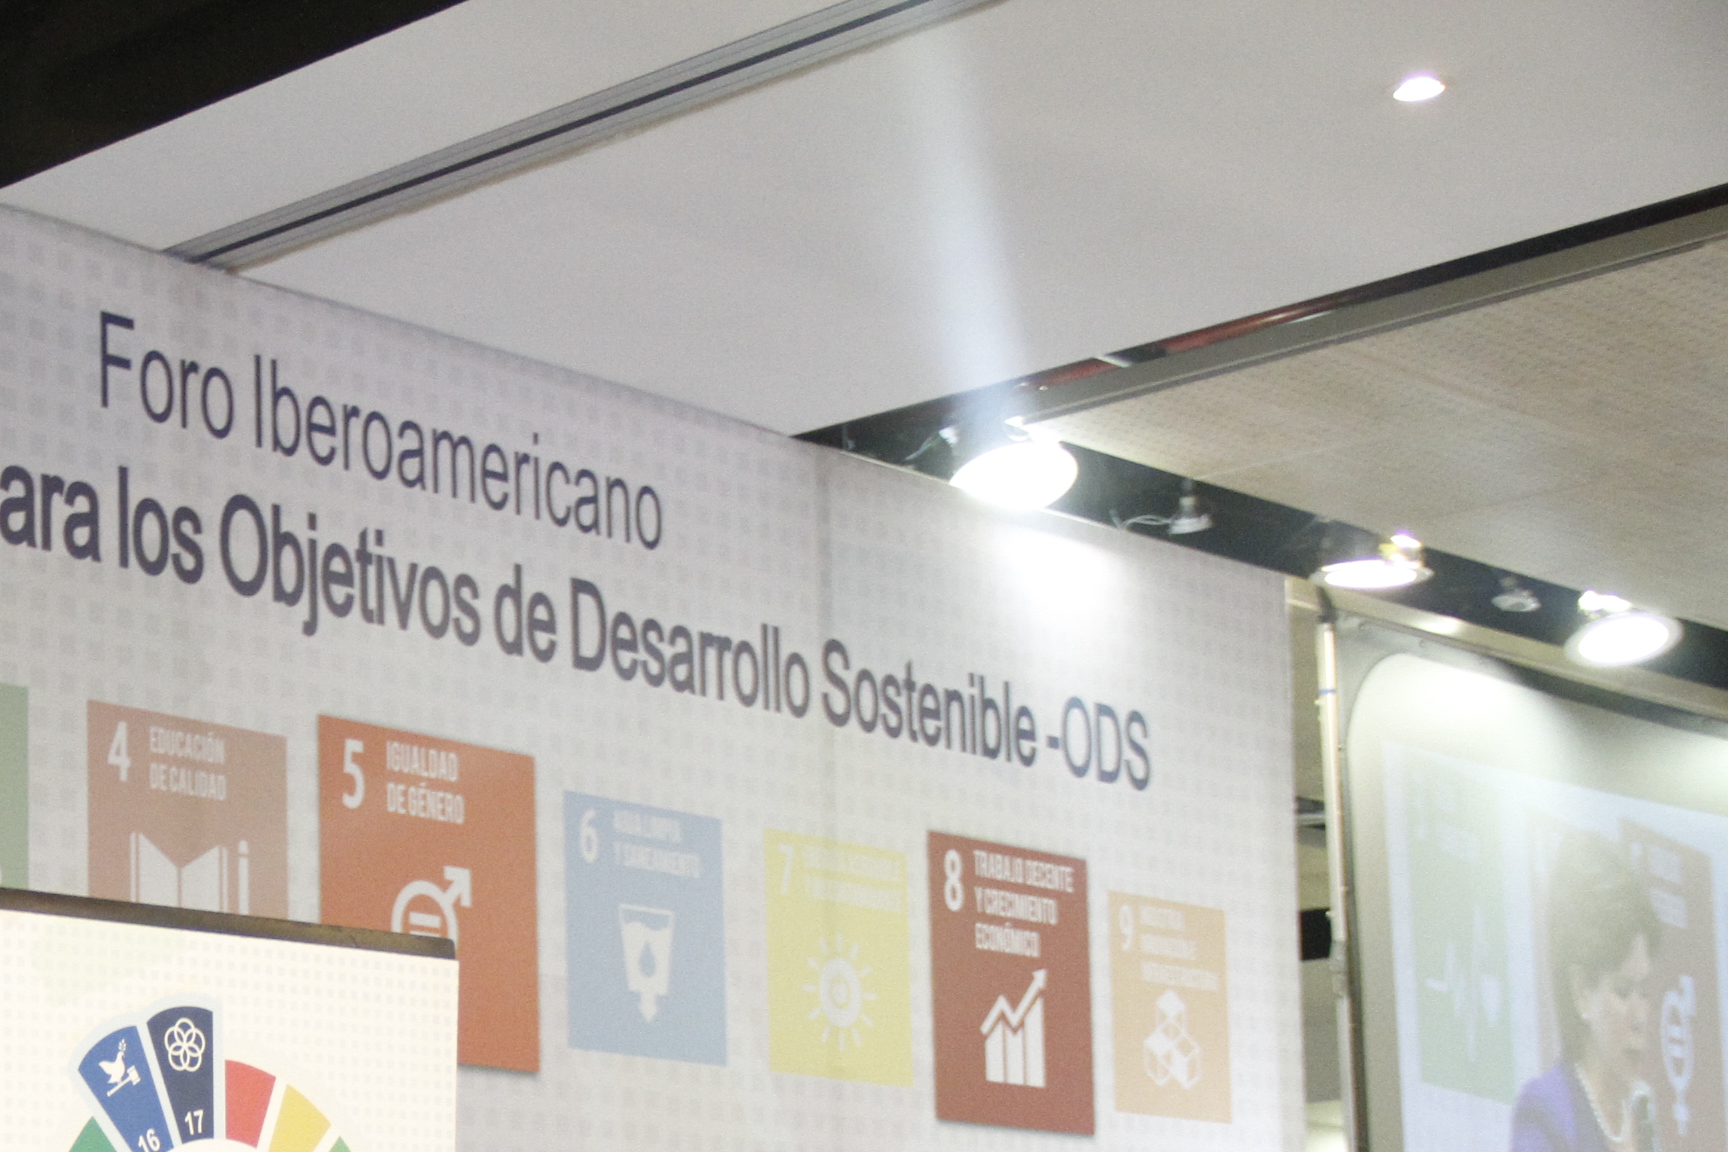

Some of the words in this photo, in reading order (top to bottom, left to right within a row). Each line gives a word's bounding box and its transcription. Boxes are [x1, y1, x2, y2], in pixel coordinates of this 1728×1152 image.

[99, 311, 234, 439] Foro
[254, 355, 662, 550] Iberoamericano
[118, 466, 204, 584] los
[219, 493, 480, 646] Objetivos
[495, 563, 557, 663] de
[570, 577, 809, 718] Desarrollo
[822, 638, 1037, 768] Sostenible
[107, 721, 131, 782] 4
[342, 738, 365, 809] 5
[386, 740, 459, 782] IGUALDAD
[150, 763, 168, 791] DE
[169, 765, 226, 800] CALIDAD
[387, 782, 406, 814] DE
[408, 782, 465, 824] GÉNERO
[579, 809, 600, 864] 6
[779, 844, 794, 895] 7
[944, 849, 963, 912] 8
[1119, 904, 1134, 951] 9
[185, 1109, 204, 1136] 17
